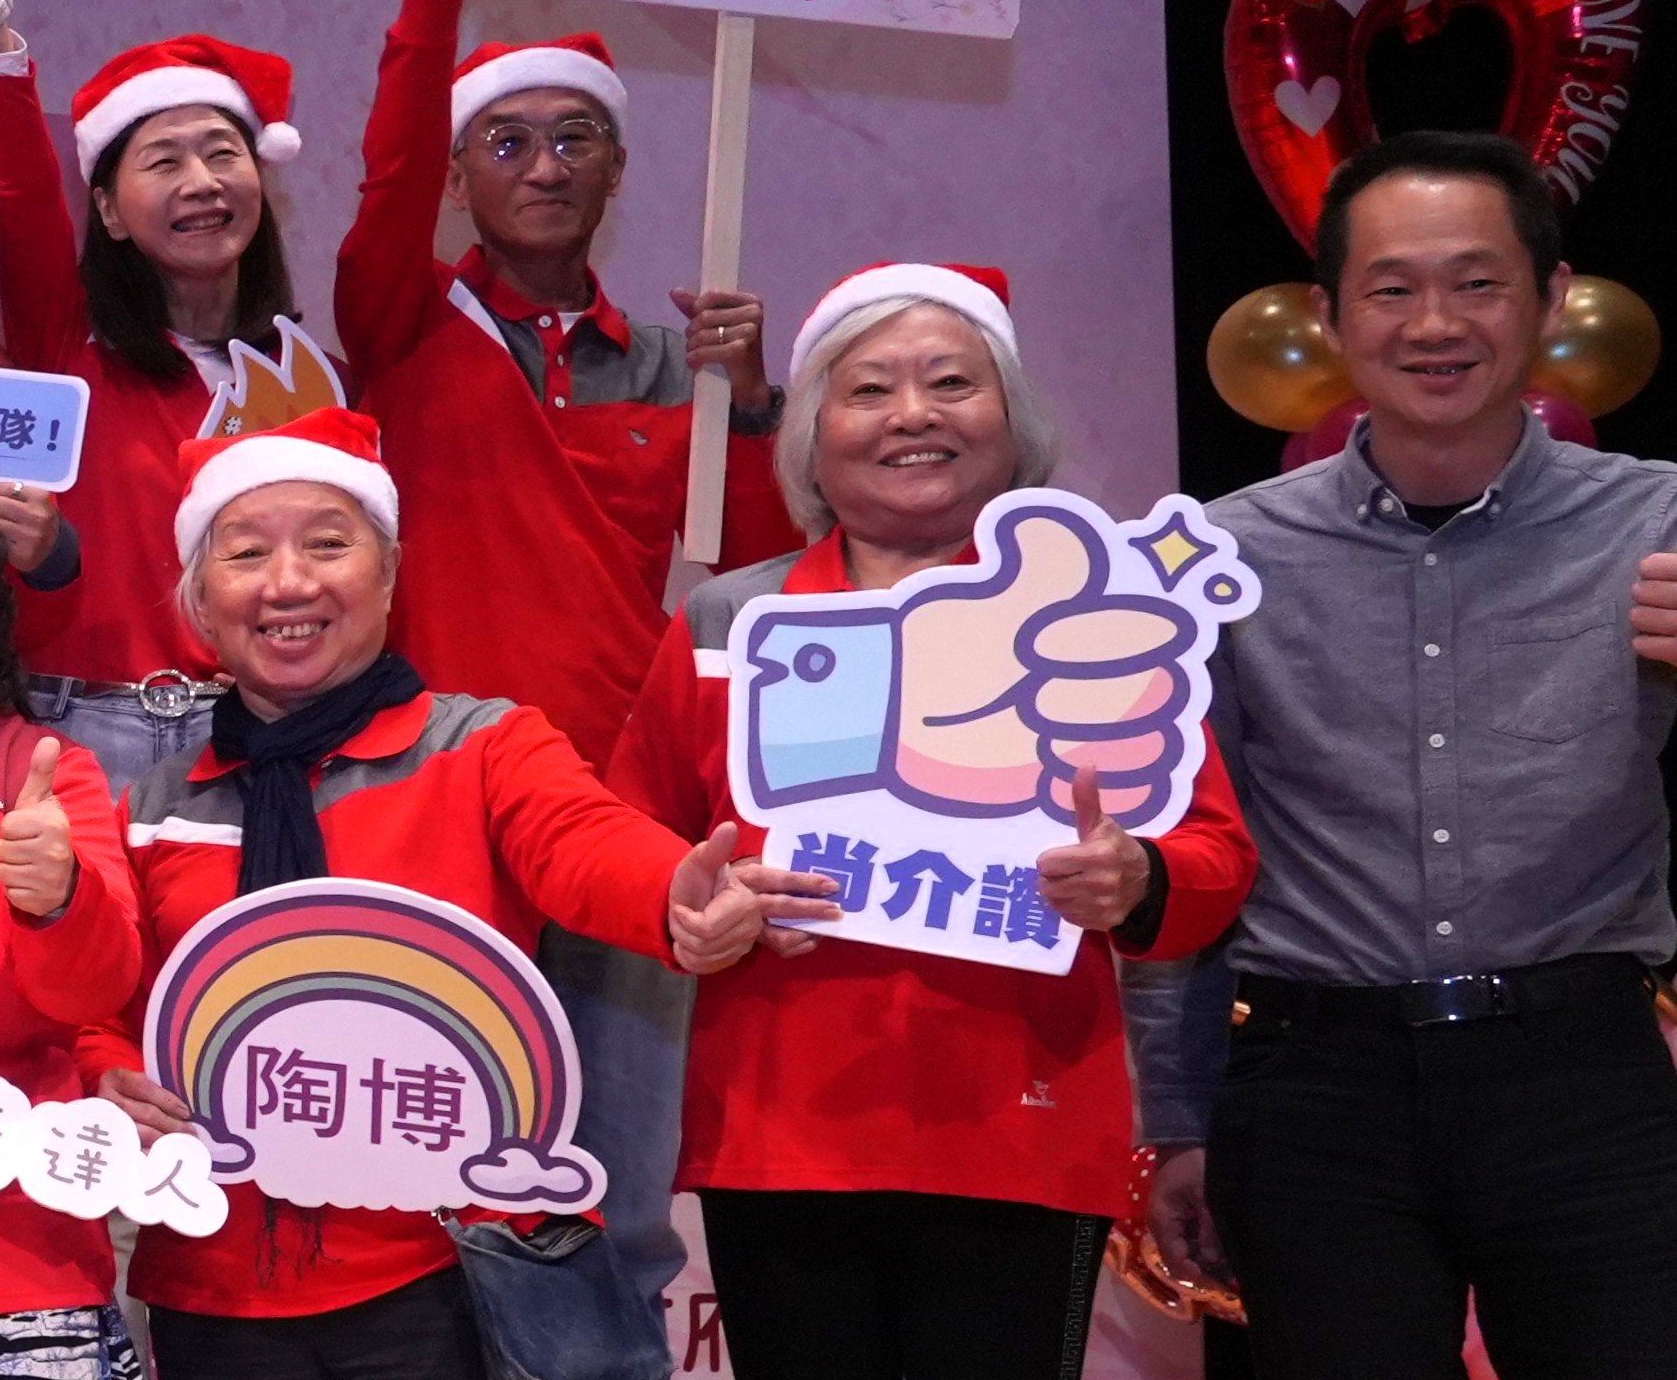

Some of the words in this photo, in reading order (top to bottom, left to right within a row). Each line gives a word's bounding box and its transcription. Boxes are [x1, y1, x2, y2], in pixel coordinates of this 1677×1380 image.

[789, 830, 1062, 951] 尚介讚
[245, 1045, 467, 1153] 陶博
